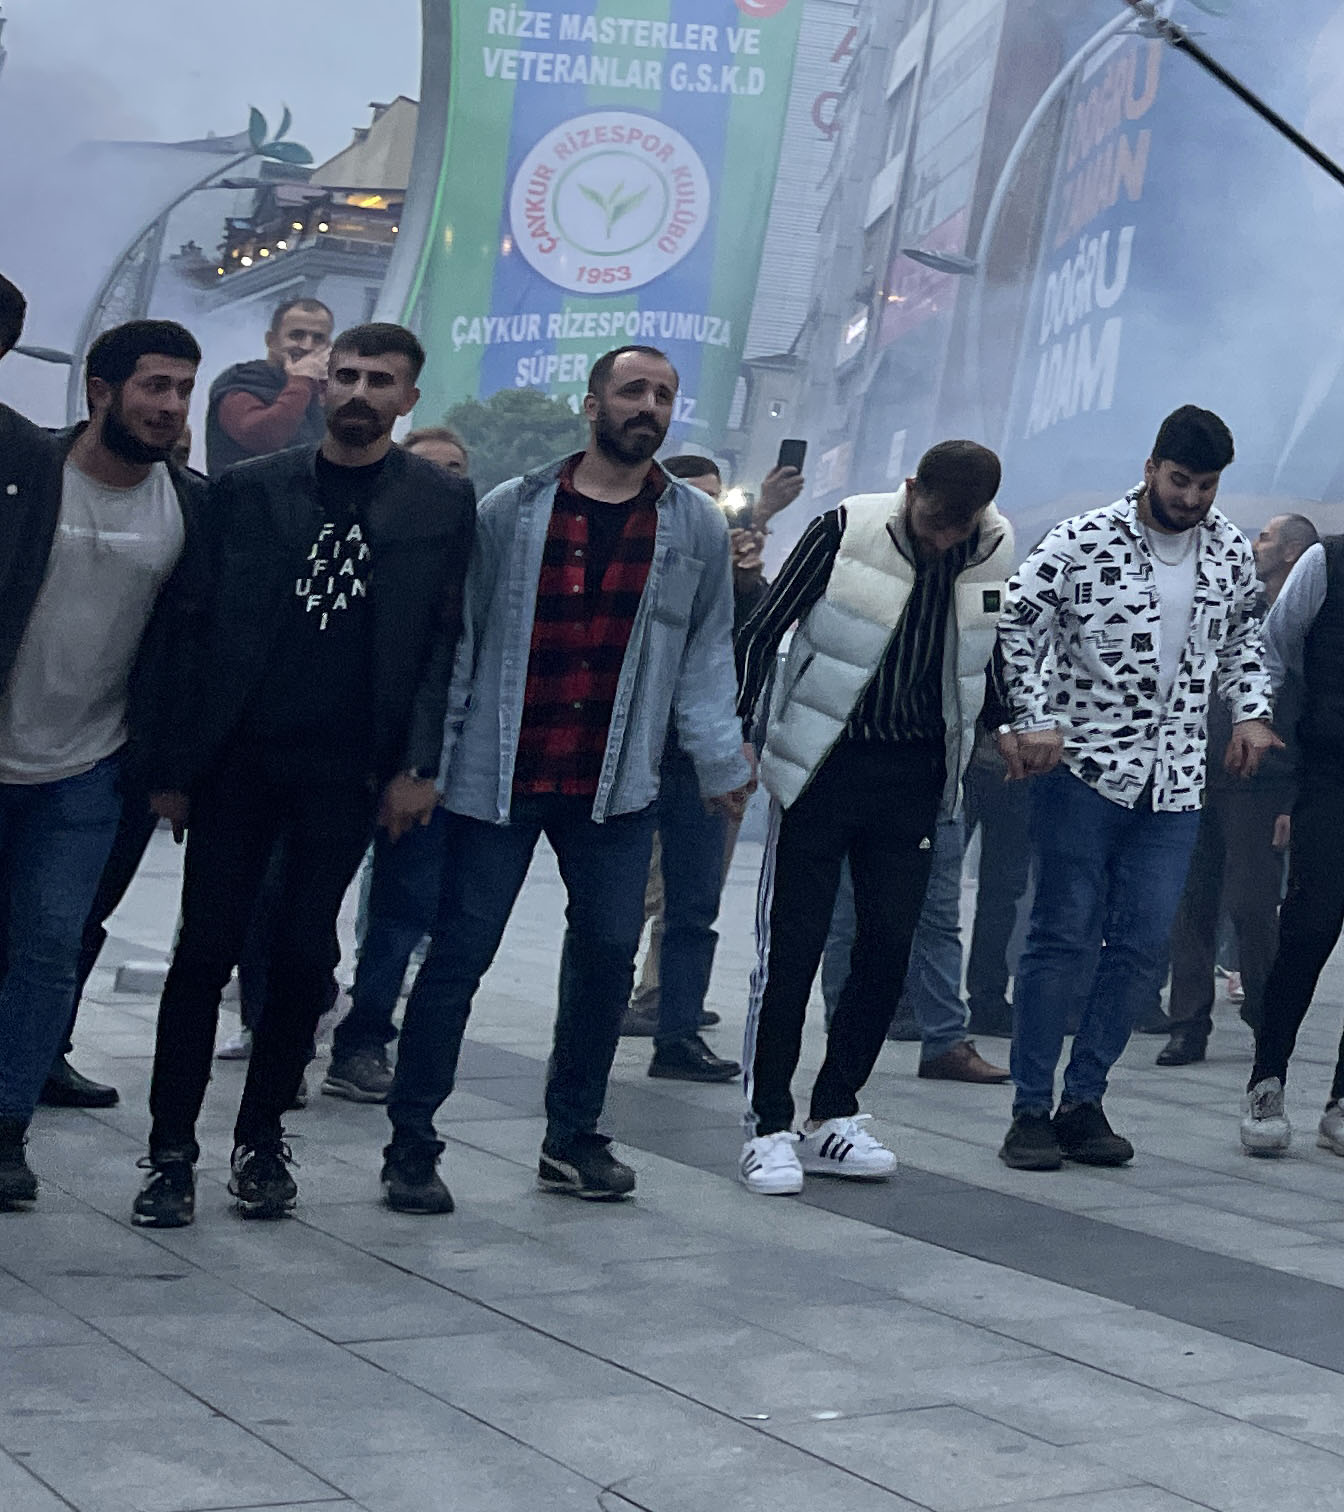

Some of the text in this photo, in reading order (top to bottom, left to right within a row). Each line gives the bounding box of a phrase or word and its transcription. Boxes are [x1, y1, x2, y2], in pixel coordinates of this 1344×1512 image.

[487, 3, 761, 55] RİZE MASTERLER VE
[482, 47, 662, 90] VETERANLAR
[525, 163, 560, 255] ÇAYKUR
[552, 125, 675, 164] RİZESPOR
[576, 264, 633, 284] 1953
[451, 312, 541, 351] ÇAYKUR
[515, 347, 588, 387] SÜPER
